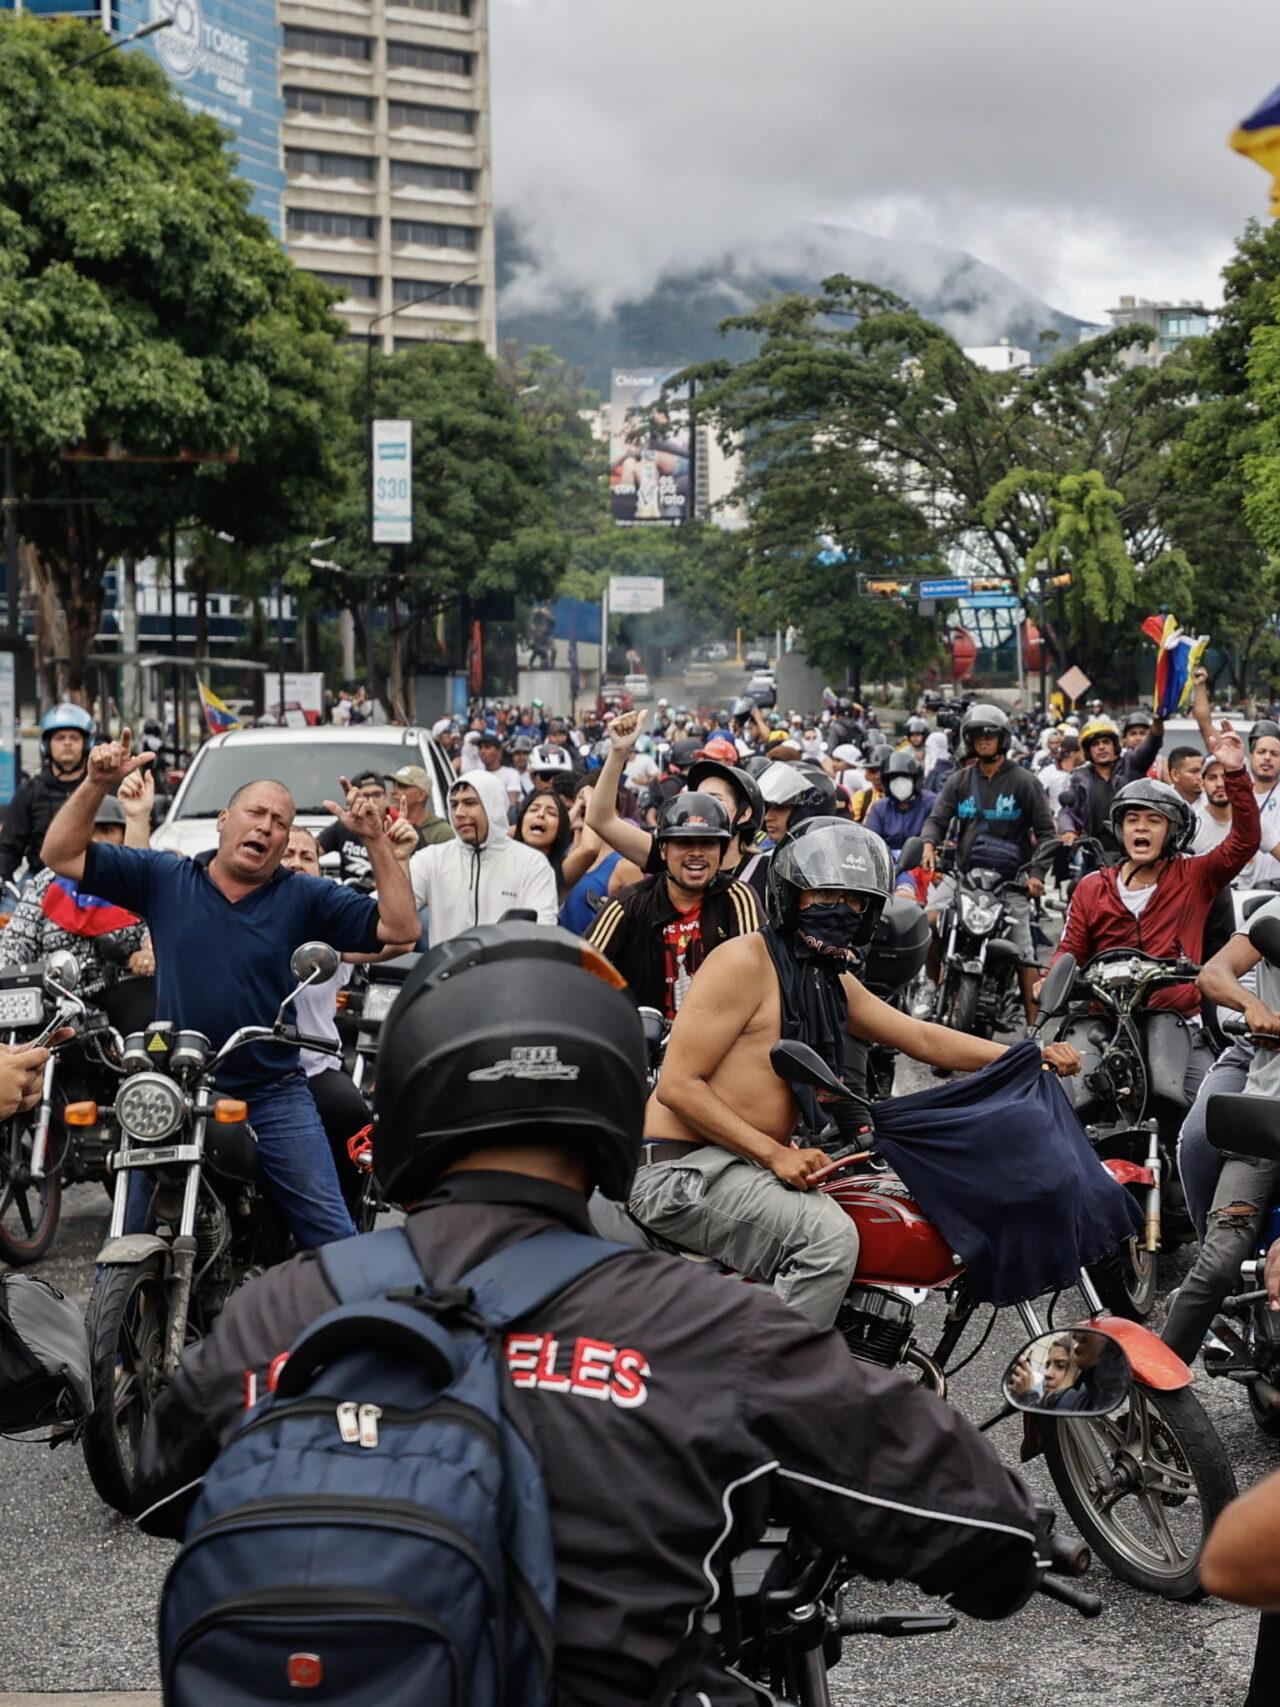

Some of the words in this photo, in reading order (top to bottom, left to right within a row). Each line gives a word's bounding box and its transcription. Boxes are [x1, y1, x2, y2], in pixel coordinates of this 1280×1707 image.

[201, 22, 249, 64] TORRE
[615, 374, 654, 386] Chisme
[377, 476, 408, 501] $30
[660, 494, 685, 506] rato
